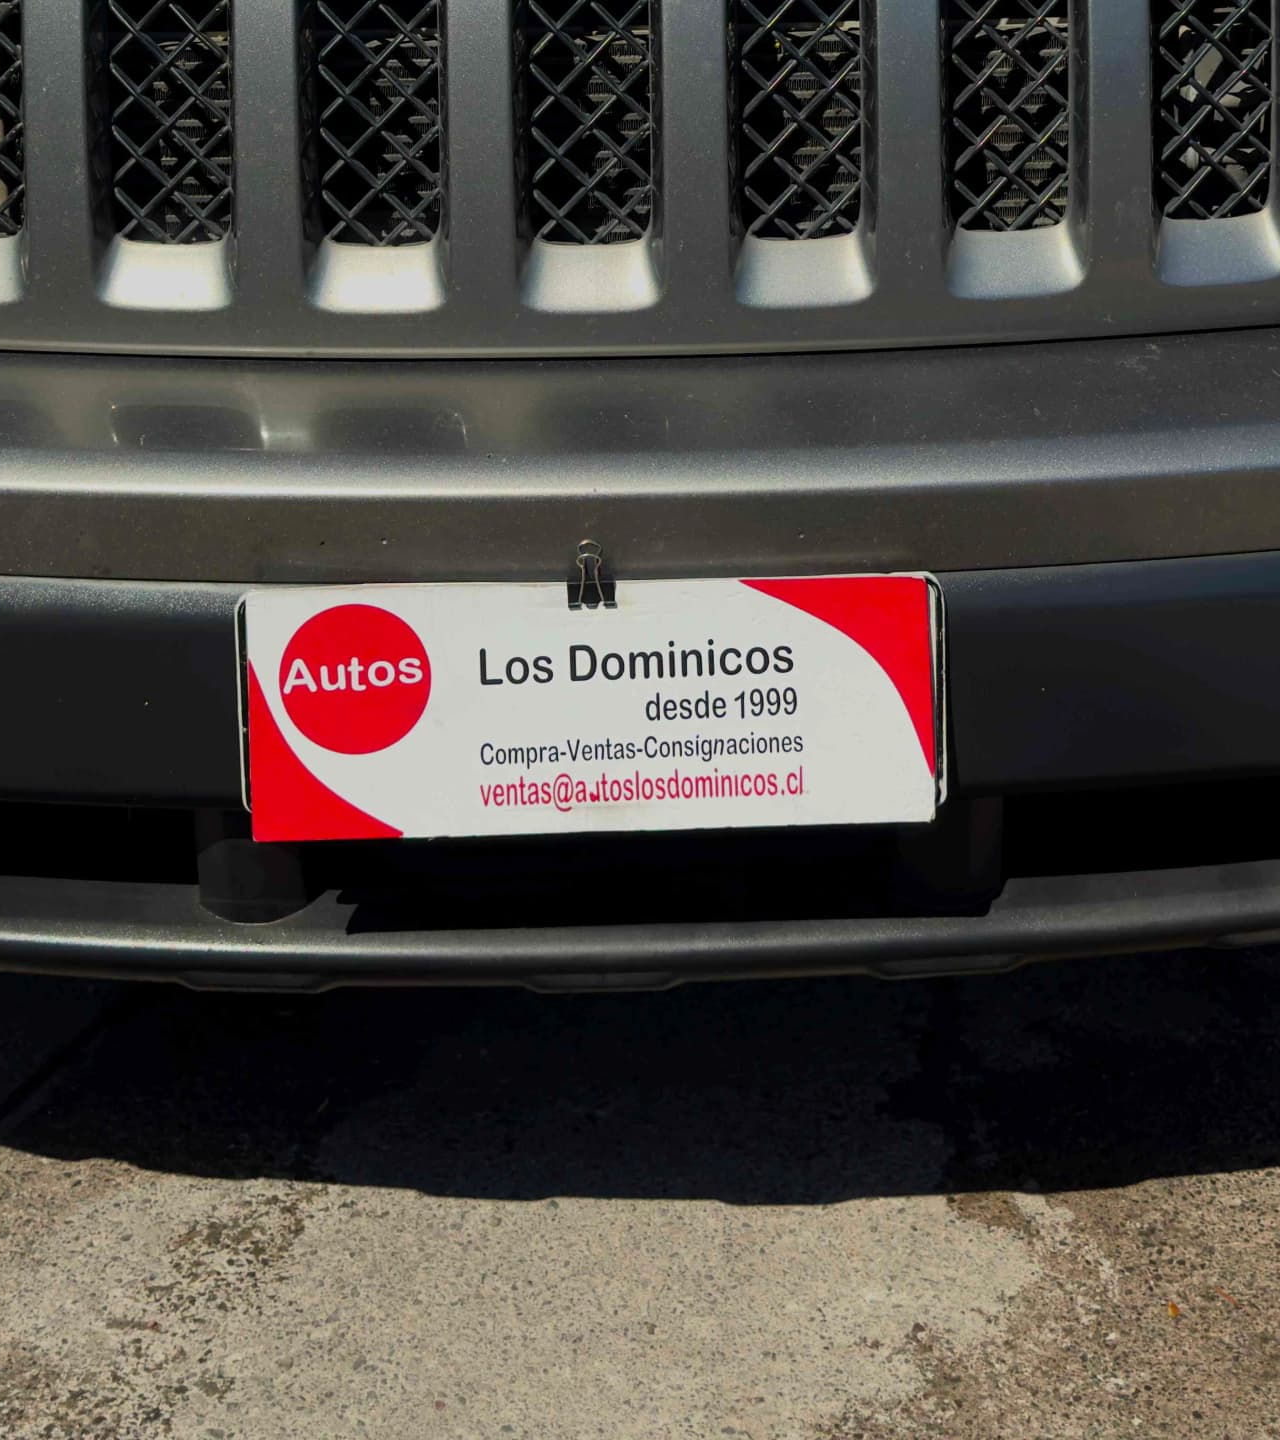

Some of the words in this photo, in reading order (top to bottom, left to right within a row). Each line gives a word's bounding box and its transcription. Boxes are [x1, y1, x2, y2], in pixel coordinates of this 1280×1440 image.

[283, 654, 424, 696] Autos
[478, 646, 556, 688] Los
[569, 639, 795, 684] Dominicos
[644, 692, 728, 722] desde
[735, 687, 799, 720] 1999
[480, 731, 805, 769] Compra-Ventas-Consignaciones
[480, 764, 804, 812] ventas@autoslosdominicos.cl
